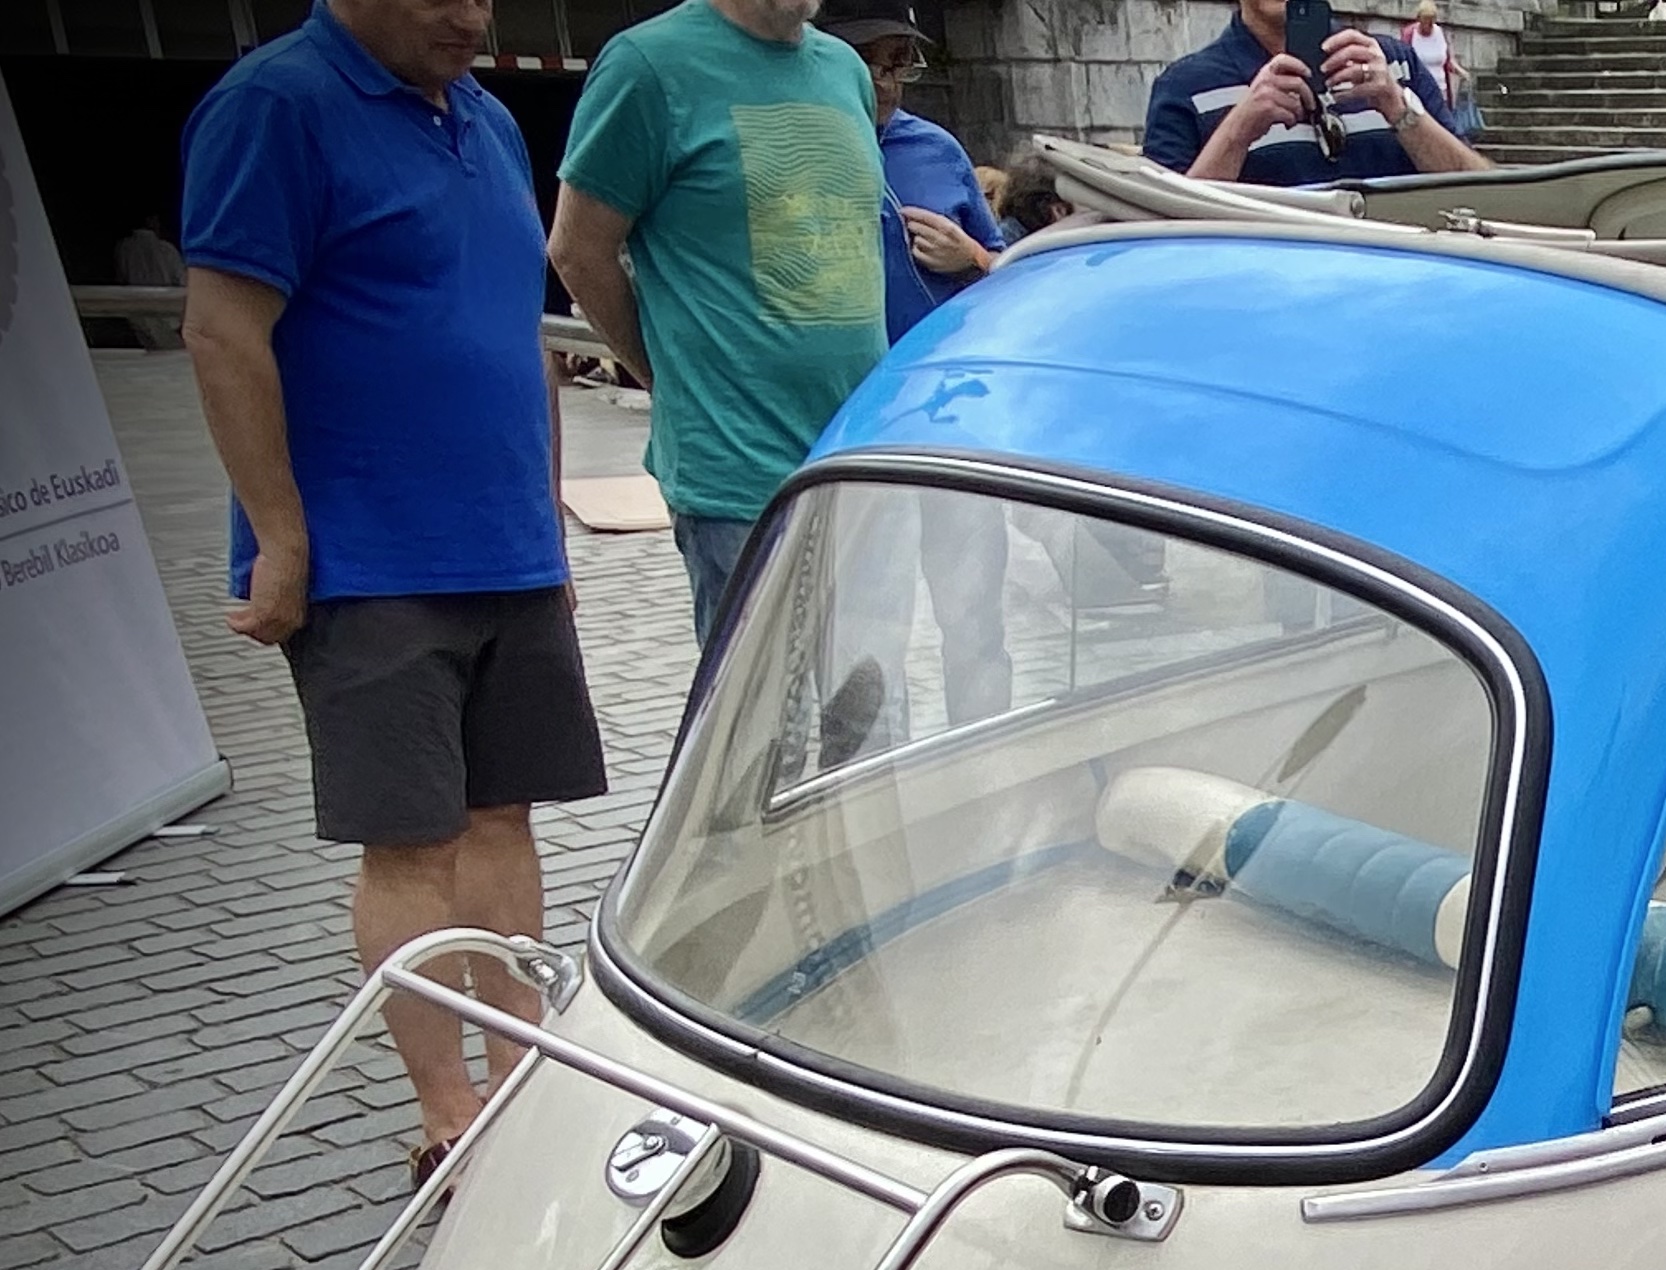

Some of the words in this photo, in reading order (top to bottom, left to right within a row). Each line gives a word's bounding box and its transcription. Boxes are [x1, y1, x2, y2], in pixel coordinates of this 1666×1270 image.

[30, 478, 51, 506] de
[49, 459, 120, 500] Euskadi
[1, 545, 54, 586] Berebil
[54, 531, 120, 568] Klasikoa
